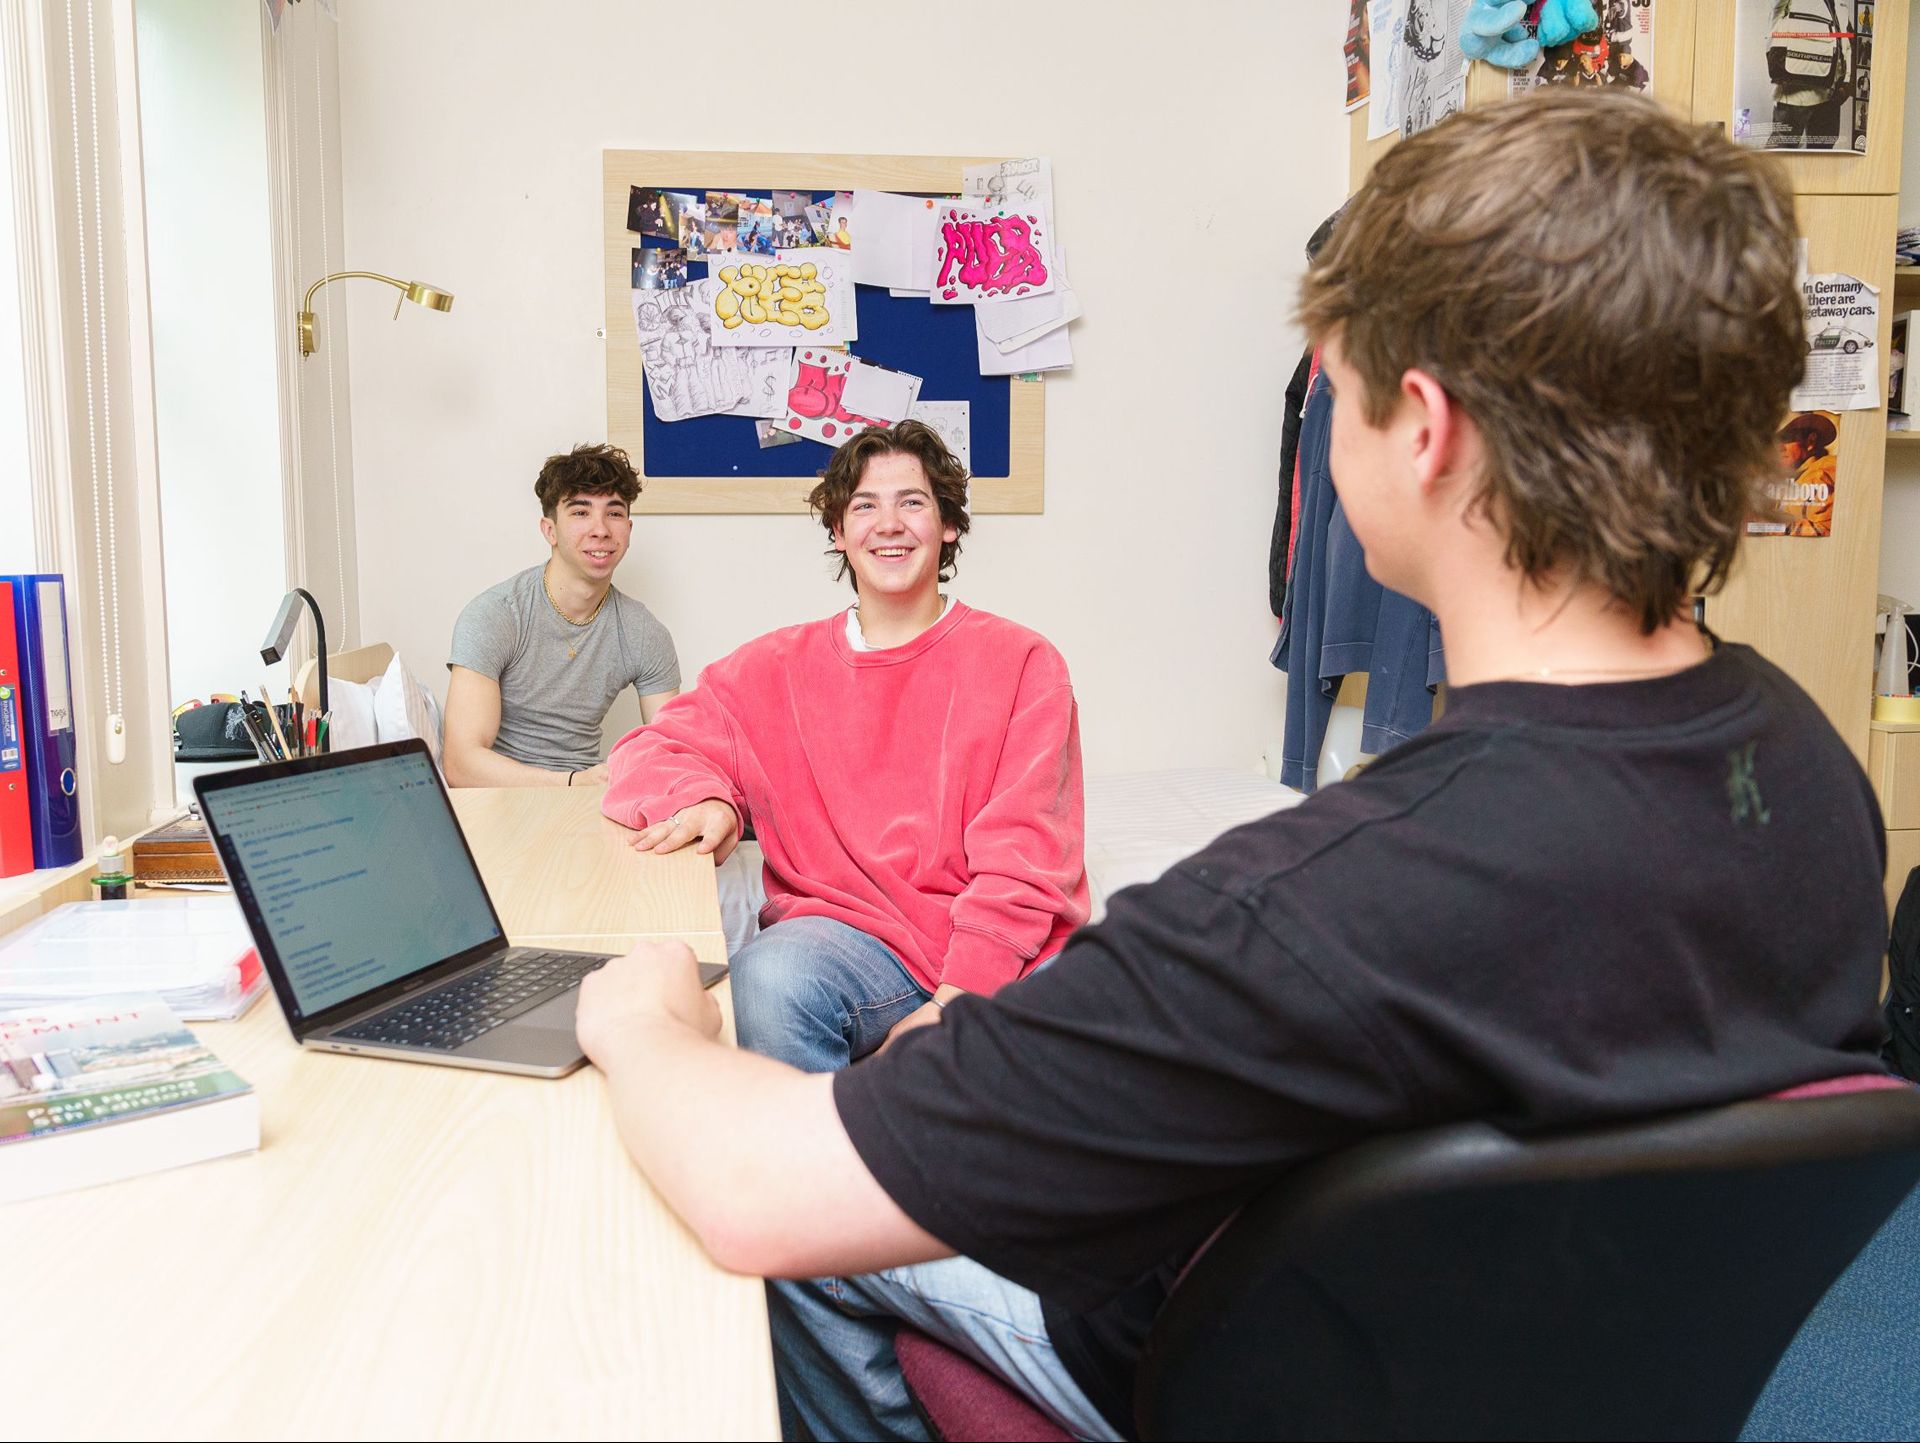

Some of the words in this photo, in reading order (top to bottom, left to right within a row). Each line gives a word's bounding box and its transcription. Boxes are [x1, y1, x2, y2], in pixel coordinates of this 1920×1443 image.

[1803, 282, 1813, 294] In
[1815, 281, 1864, 295] Germany
[1807, 294, 1836, 306] there
[1838, 295, 1856, 305] are
[1849, 304, 1876, 316] cars.
[1766, 478, 1829, 501] arlboro
